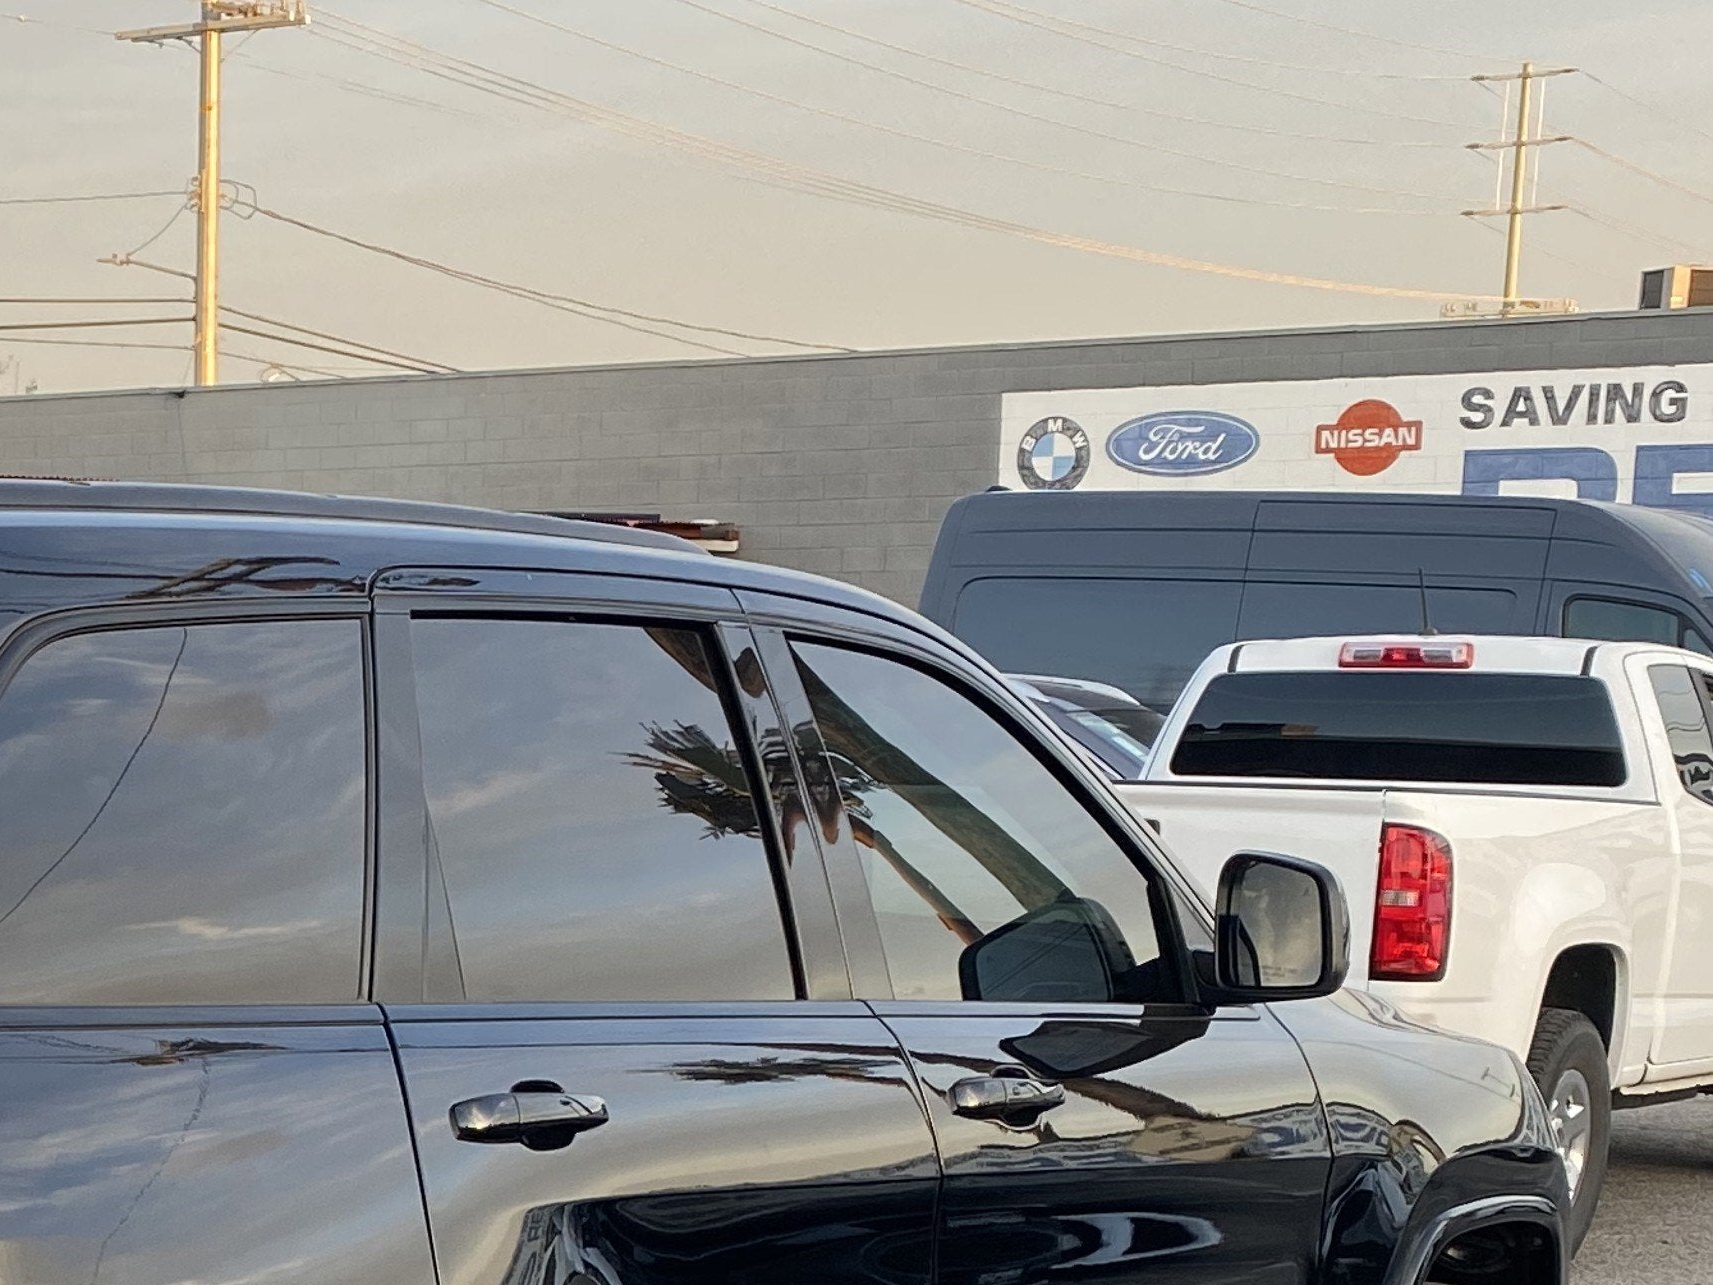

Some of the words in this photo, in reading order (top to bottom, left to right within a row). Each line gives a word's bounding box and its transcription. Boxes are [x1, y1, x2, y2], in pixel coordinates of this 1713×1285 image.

[1459, 380, 1688, 430] SAVING
[1021, 419, 1089, 452] BMW
[1139, 425, 1224, 462] Ford
[1319, 426, 1417, 450] NISSAN
